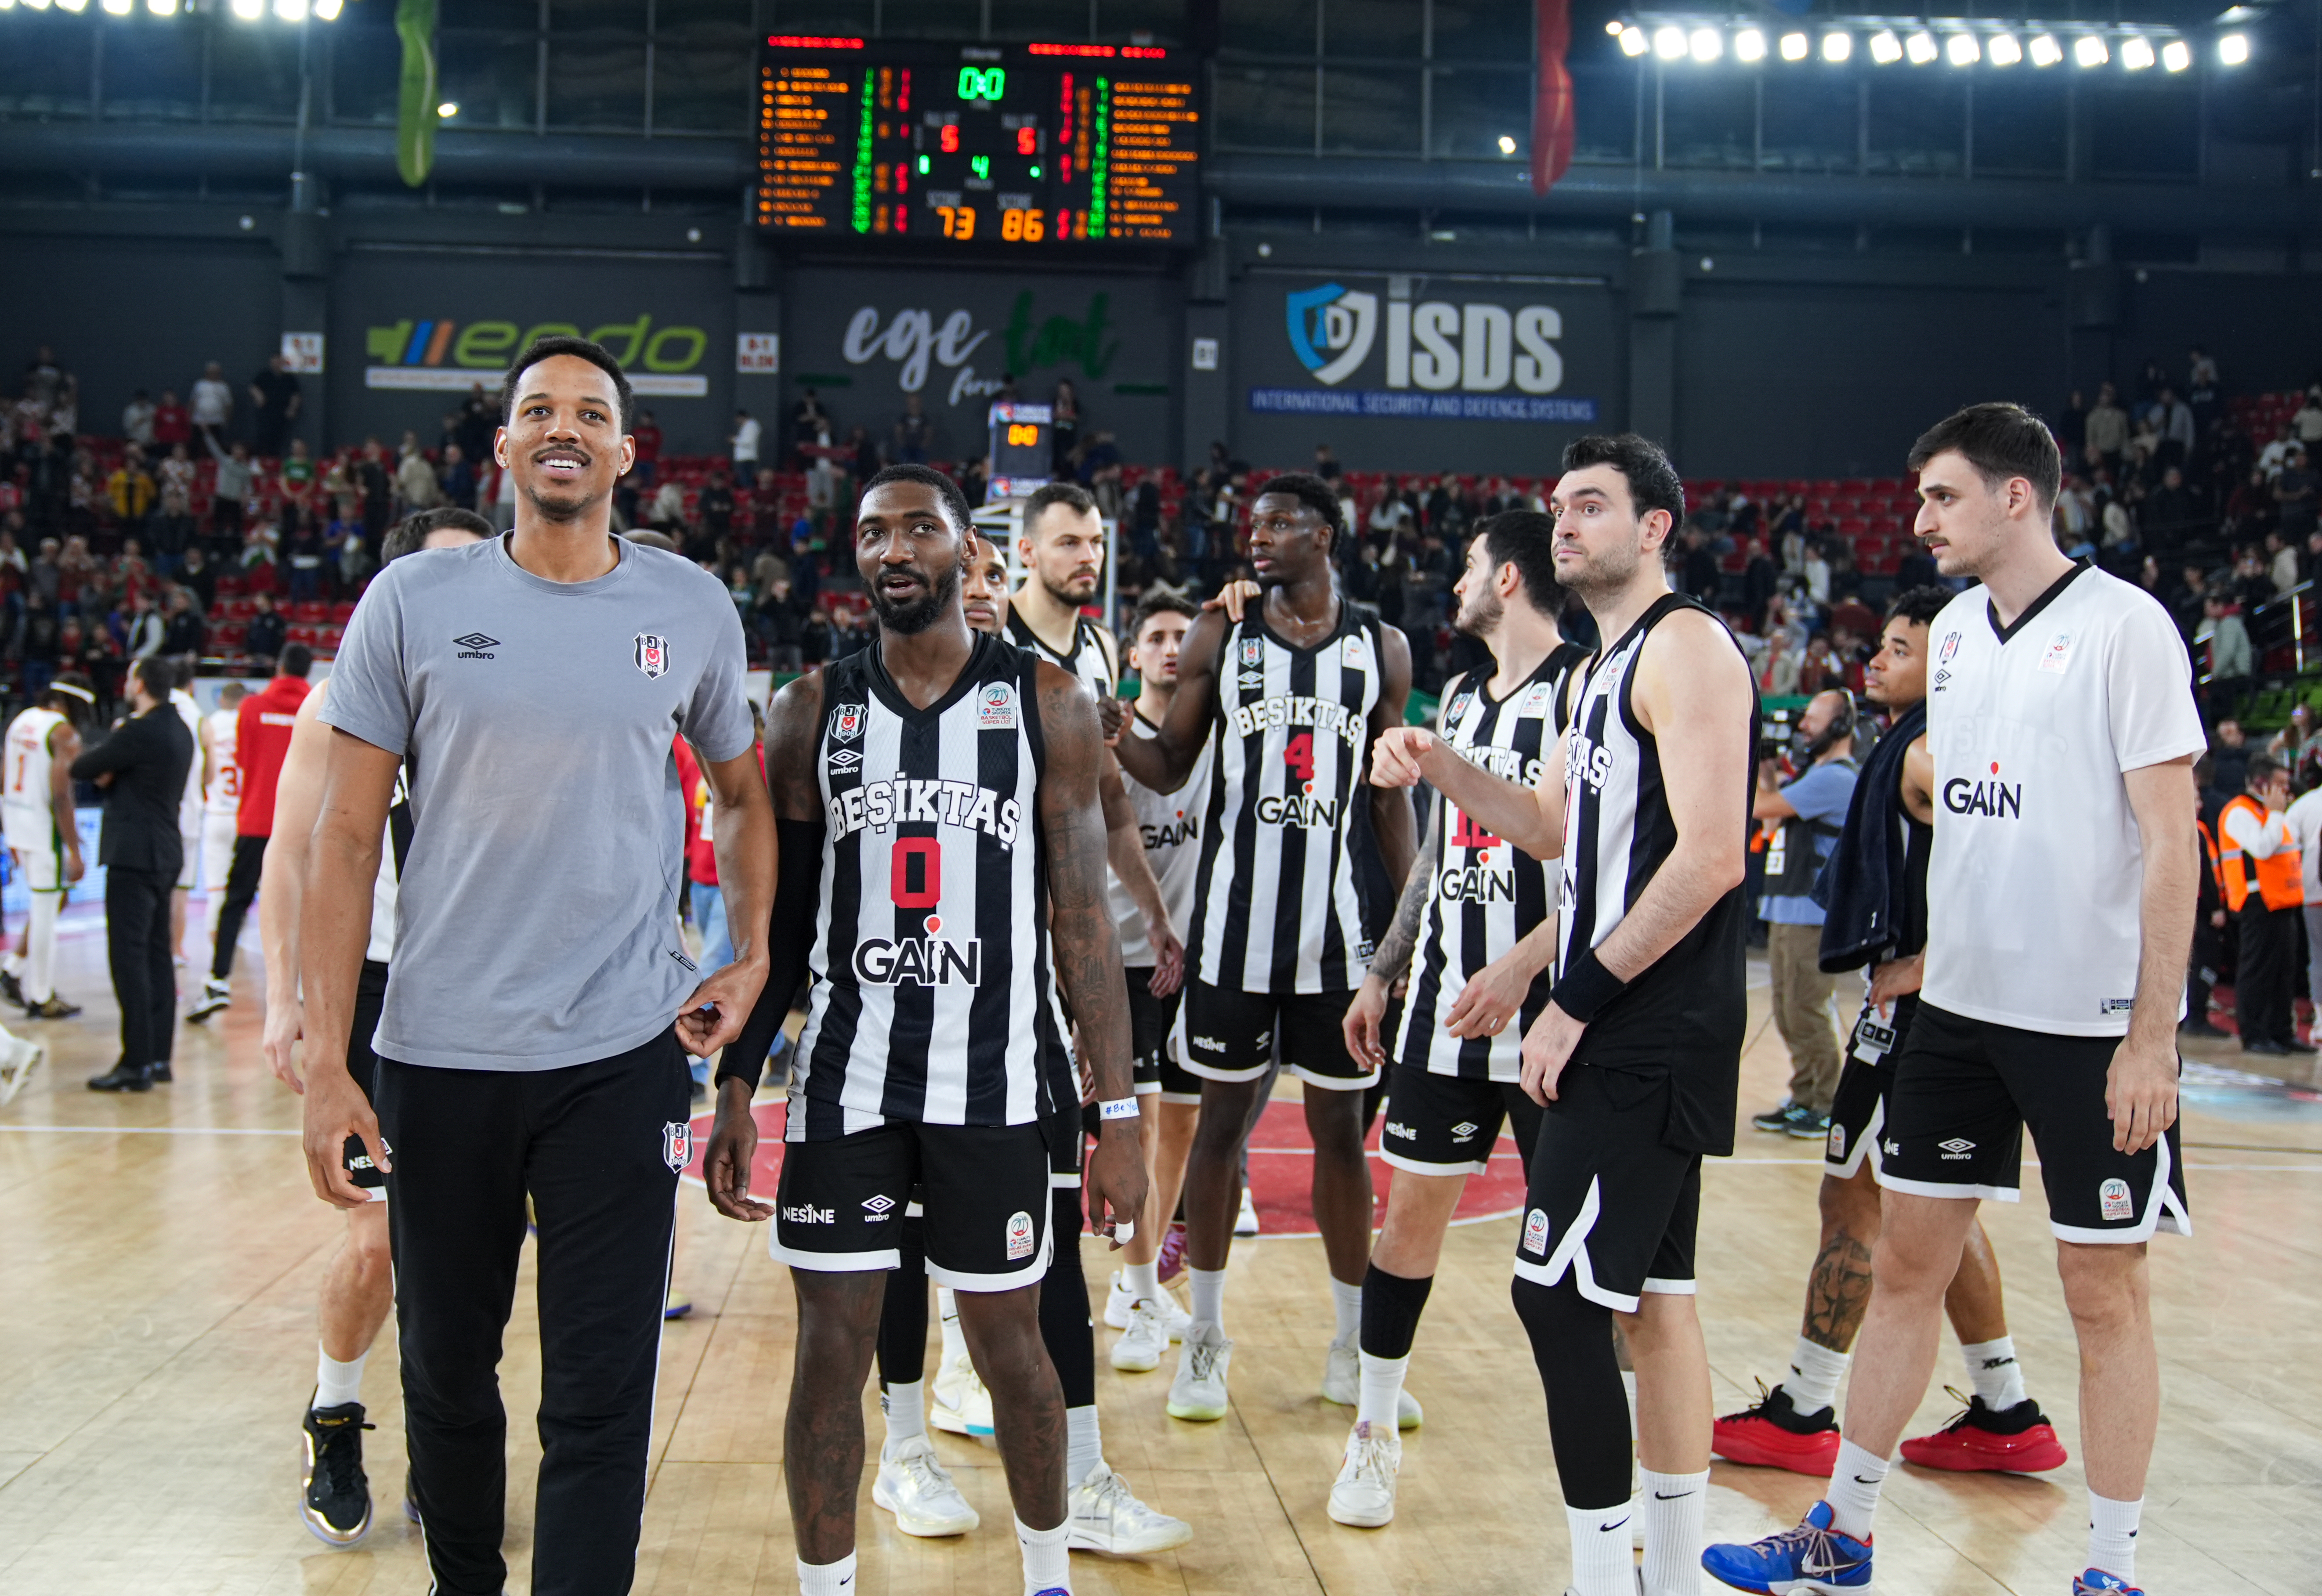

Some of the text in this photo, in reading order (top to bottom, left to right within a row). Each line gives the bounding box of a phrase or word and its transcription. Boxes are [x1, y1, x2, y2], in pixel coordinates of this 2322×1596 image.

[941, 125, 1035, 155] 5 5
[972, 155, 989, 180] 4
[936, 206, 1044, 242] 73 86
[843, 306, 990, 392] ege
[1252, 389, 1594, 422] INTERNATIONAL SECURITY AND DEFENCE SYSTEMS
[457, 650, 495, 660] umbro
[641, 637, 663, 649] BJK
[644, 665, 662, 674] 1903
[1231, 690, 1364, 747] BEŞİKTAŞ
[830, 766, 858, 775] umbro
[1283, 733, 1315, 780] 4
[829, 771, 1021, 852] BEŞİKTAŞ
[890, 837, 940, 909] 0
[670, 1127, 688, 1137] BJK
[864, 1213, 890, 1222] umbro
